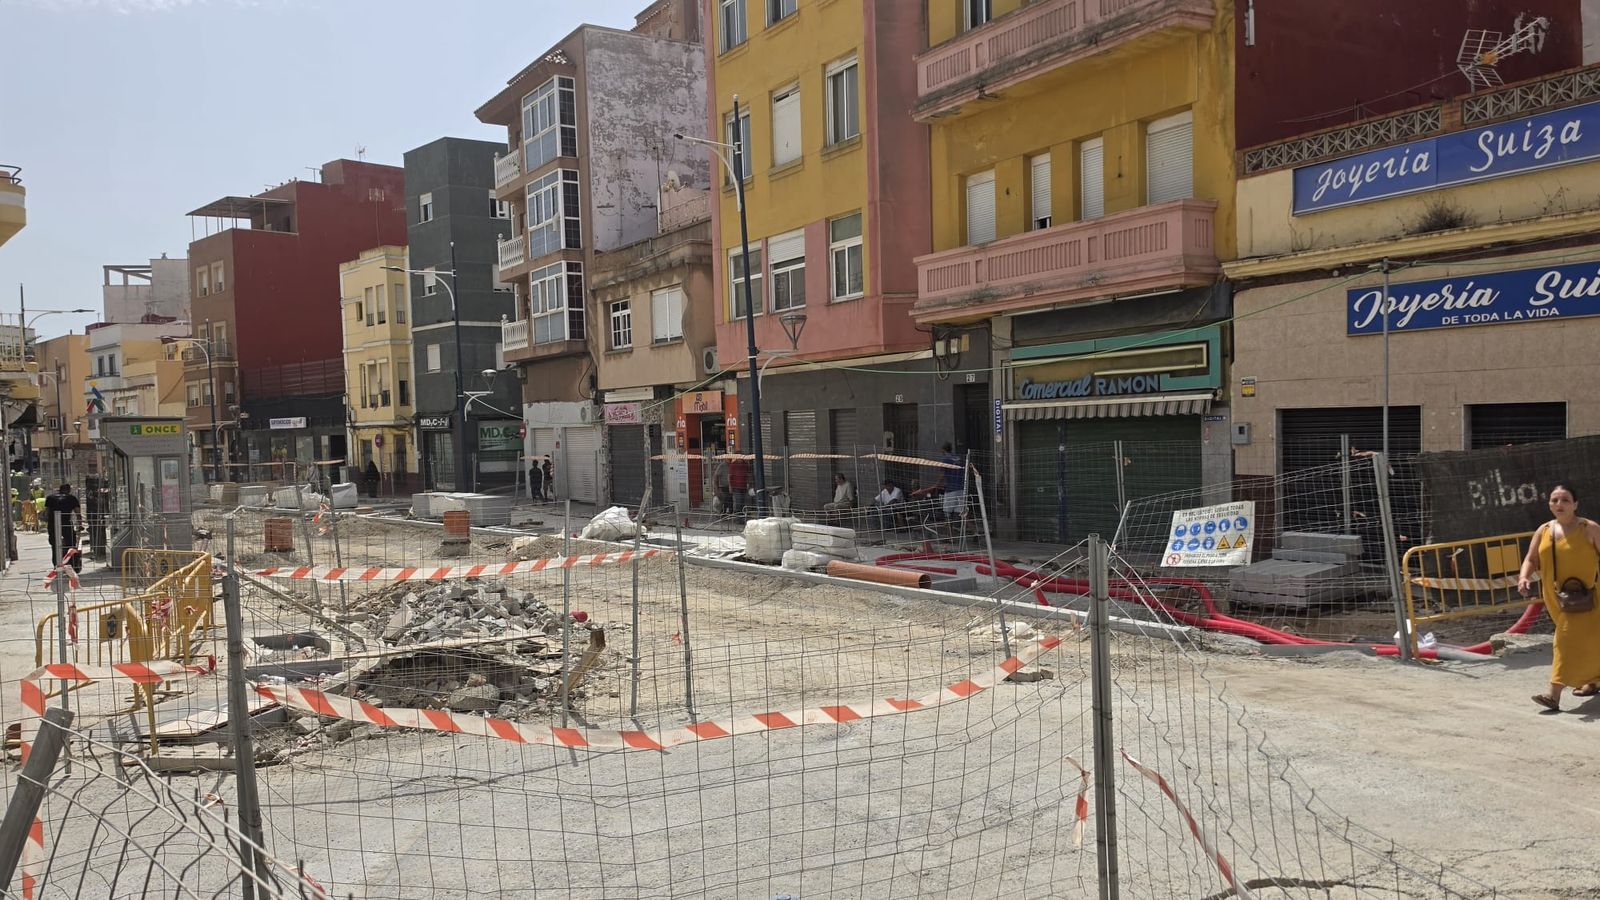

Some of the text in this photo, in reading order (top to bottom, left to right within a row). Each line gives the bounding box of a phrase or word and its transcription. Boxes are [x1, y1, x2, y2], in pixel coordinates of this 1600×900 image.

[1470, 119, 1583, 172] Suiza
[1354, 281, 1500, 328] Joyería
[1442, 307, 1560, 325] DE TODA LA VIDA
[1019, 374, 1159, 400] Comercial RAMON
